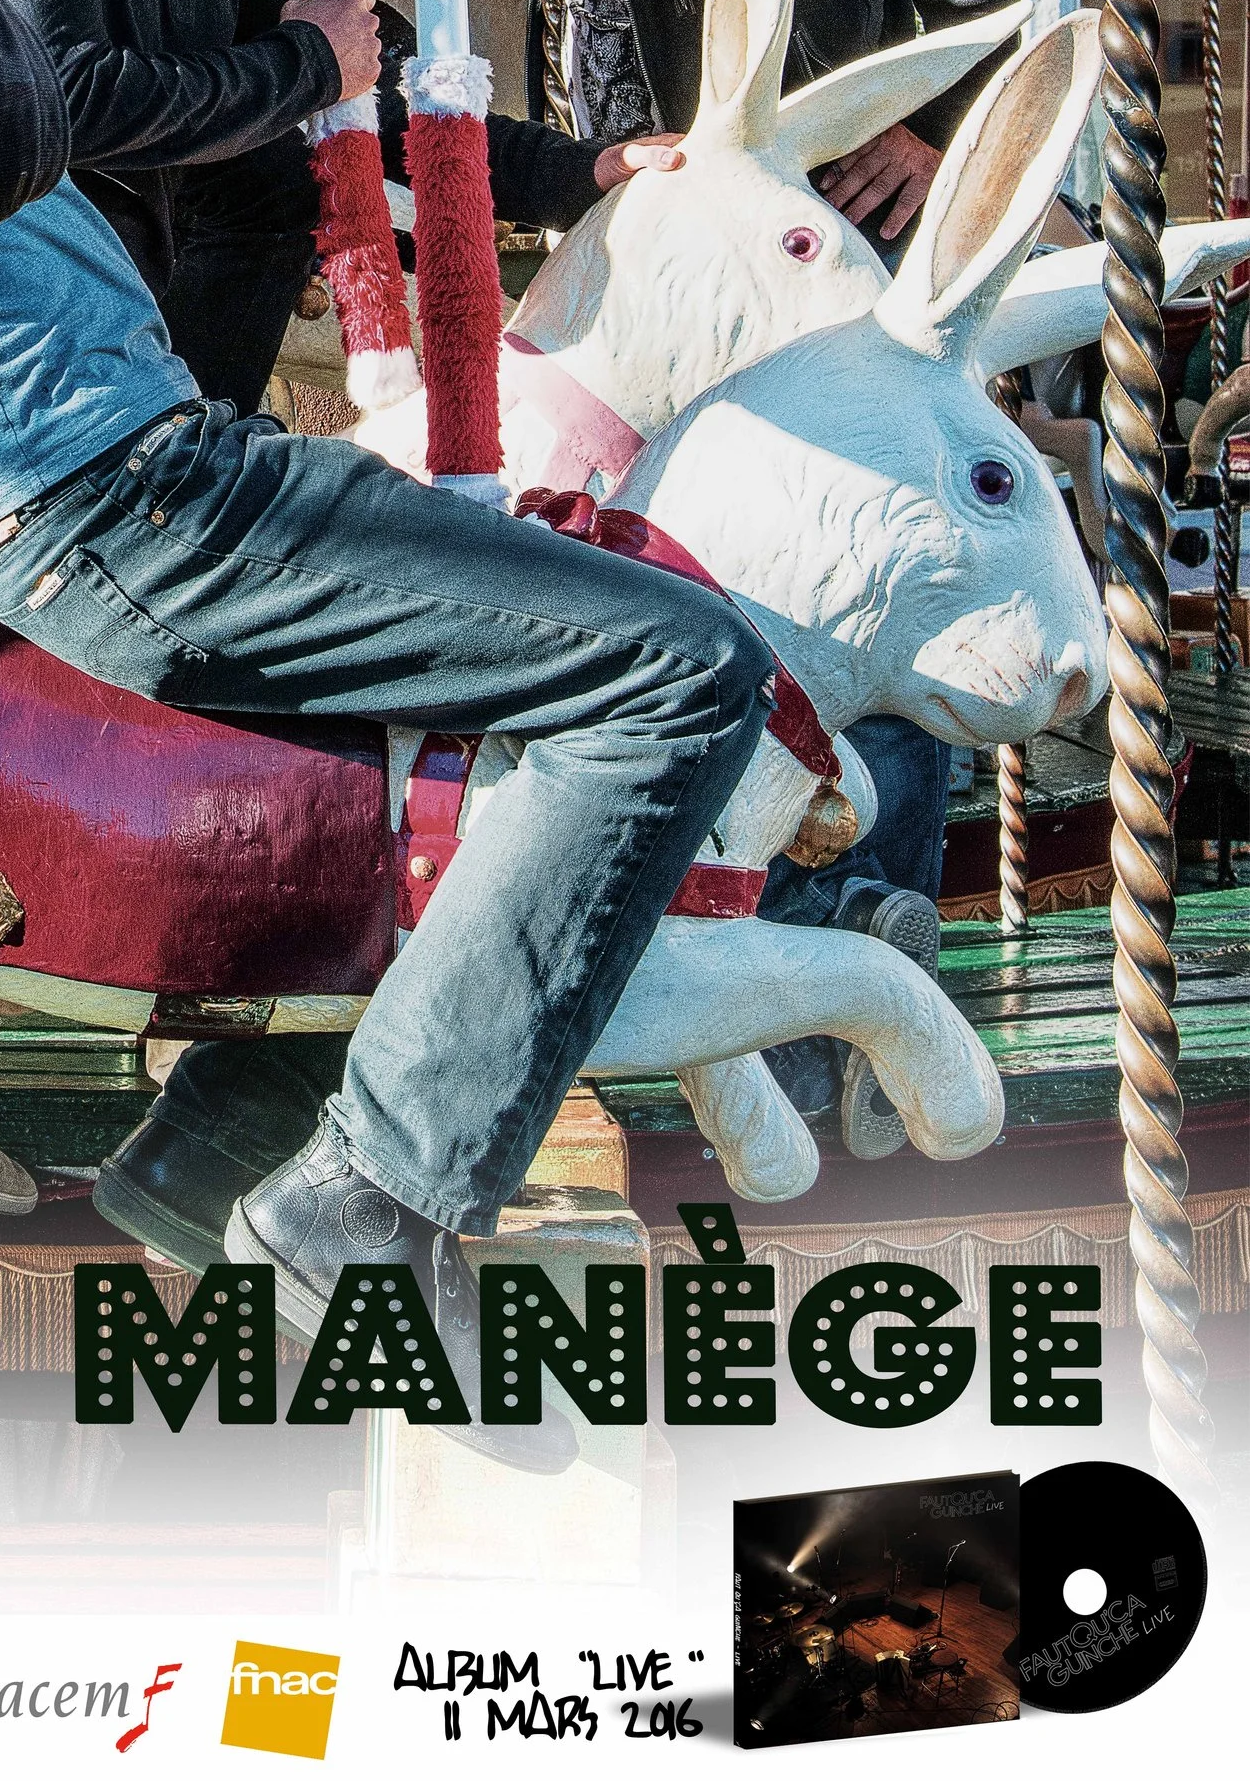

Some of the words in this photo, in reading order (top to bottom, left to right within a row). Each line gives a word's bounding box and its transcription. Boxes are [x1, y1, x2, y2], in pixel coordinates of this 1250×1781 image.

[985, 1501, 1006, 1512] LIVE
[1047, 1619, 1140, 1687] GUINCHE
[1142, 1605, 1176, 1635] LIVE
